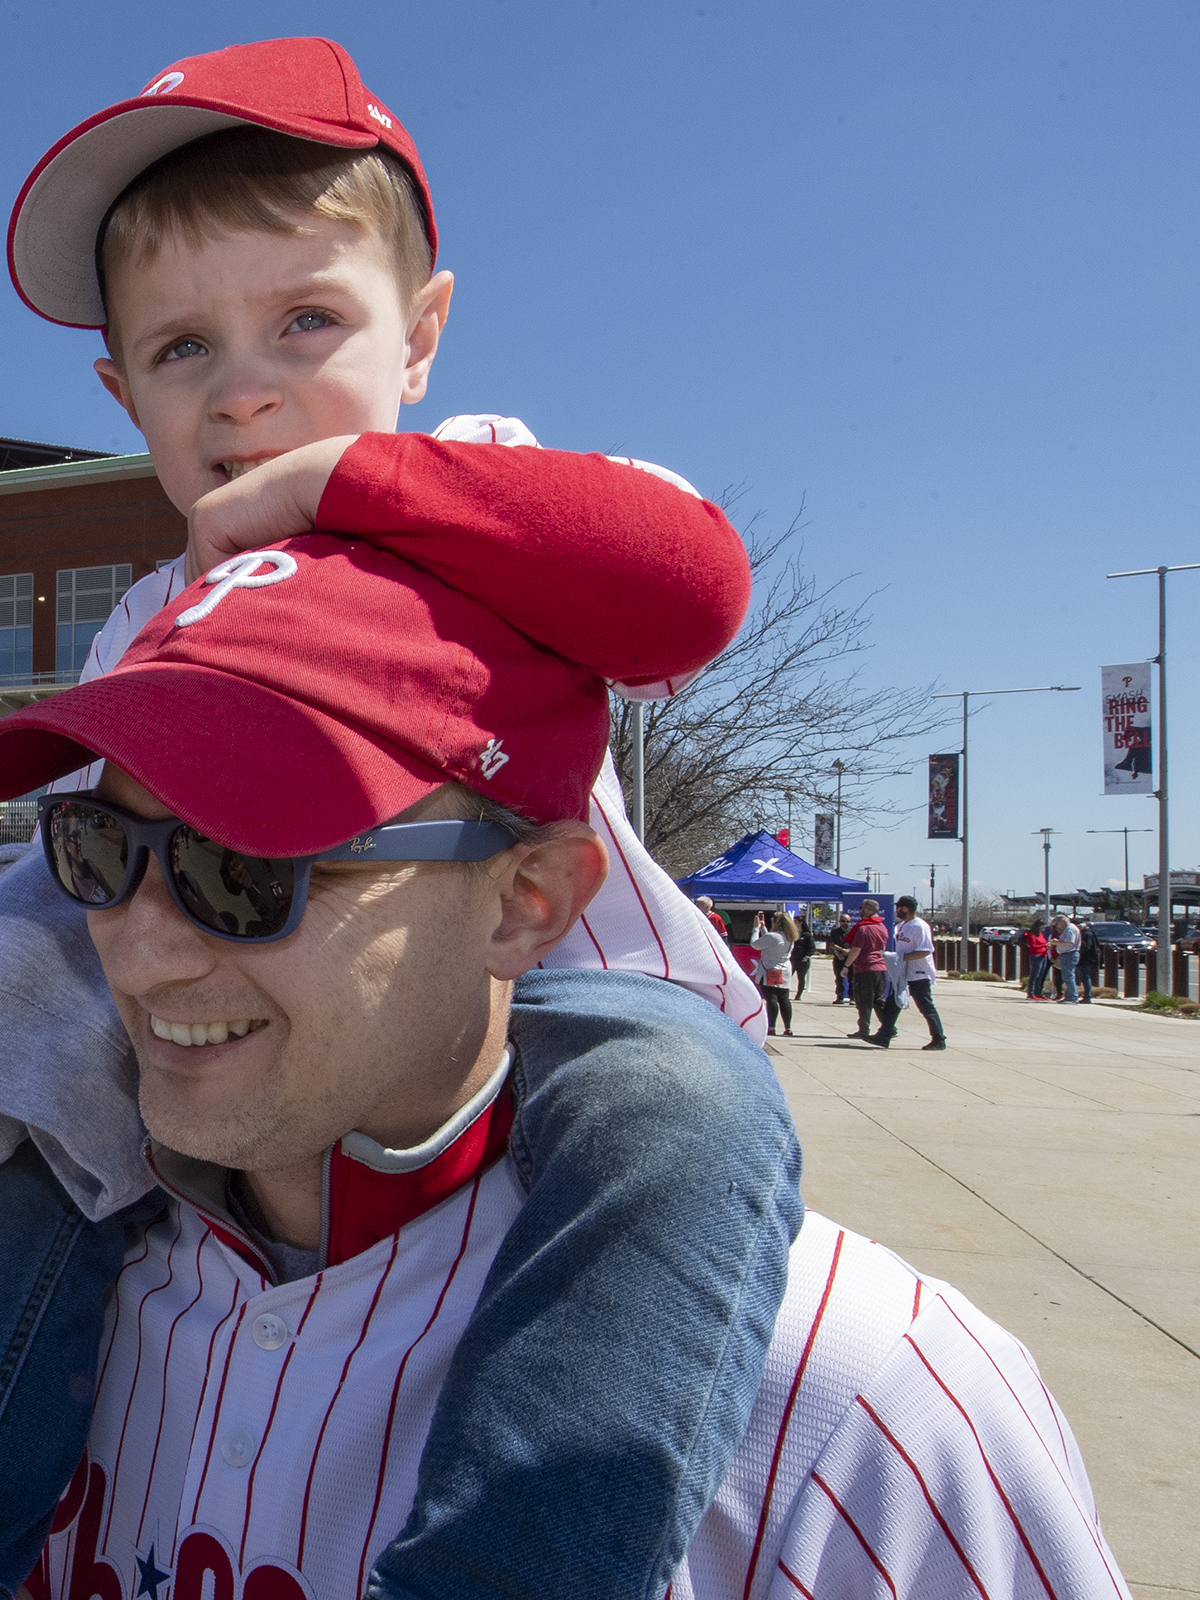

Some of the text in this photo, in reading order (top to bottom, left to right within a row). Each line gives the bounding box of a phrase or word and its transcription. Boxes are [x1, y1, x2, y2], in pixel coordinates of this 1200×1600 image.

[174, 549, 298, 627] P
[1108, 696, 1148, 715] RING
[1105, 715, 1135, 732] THE
